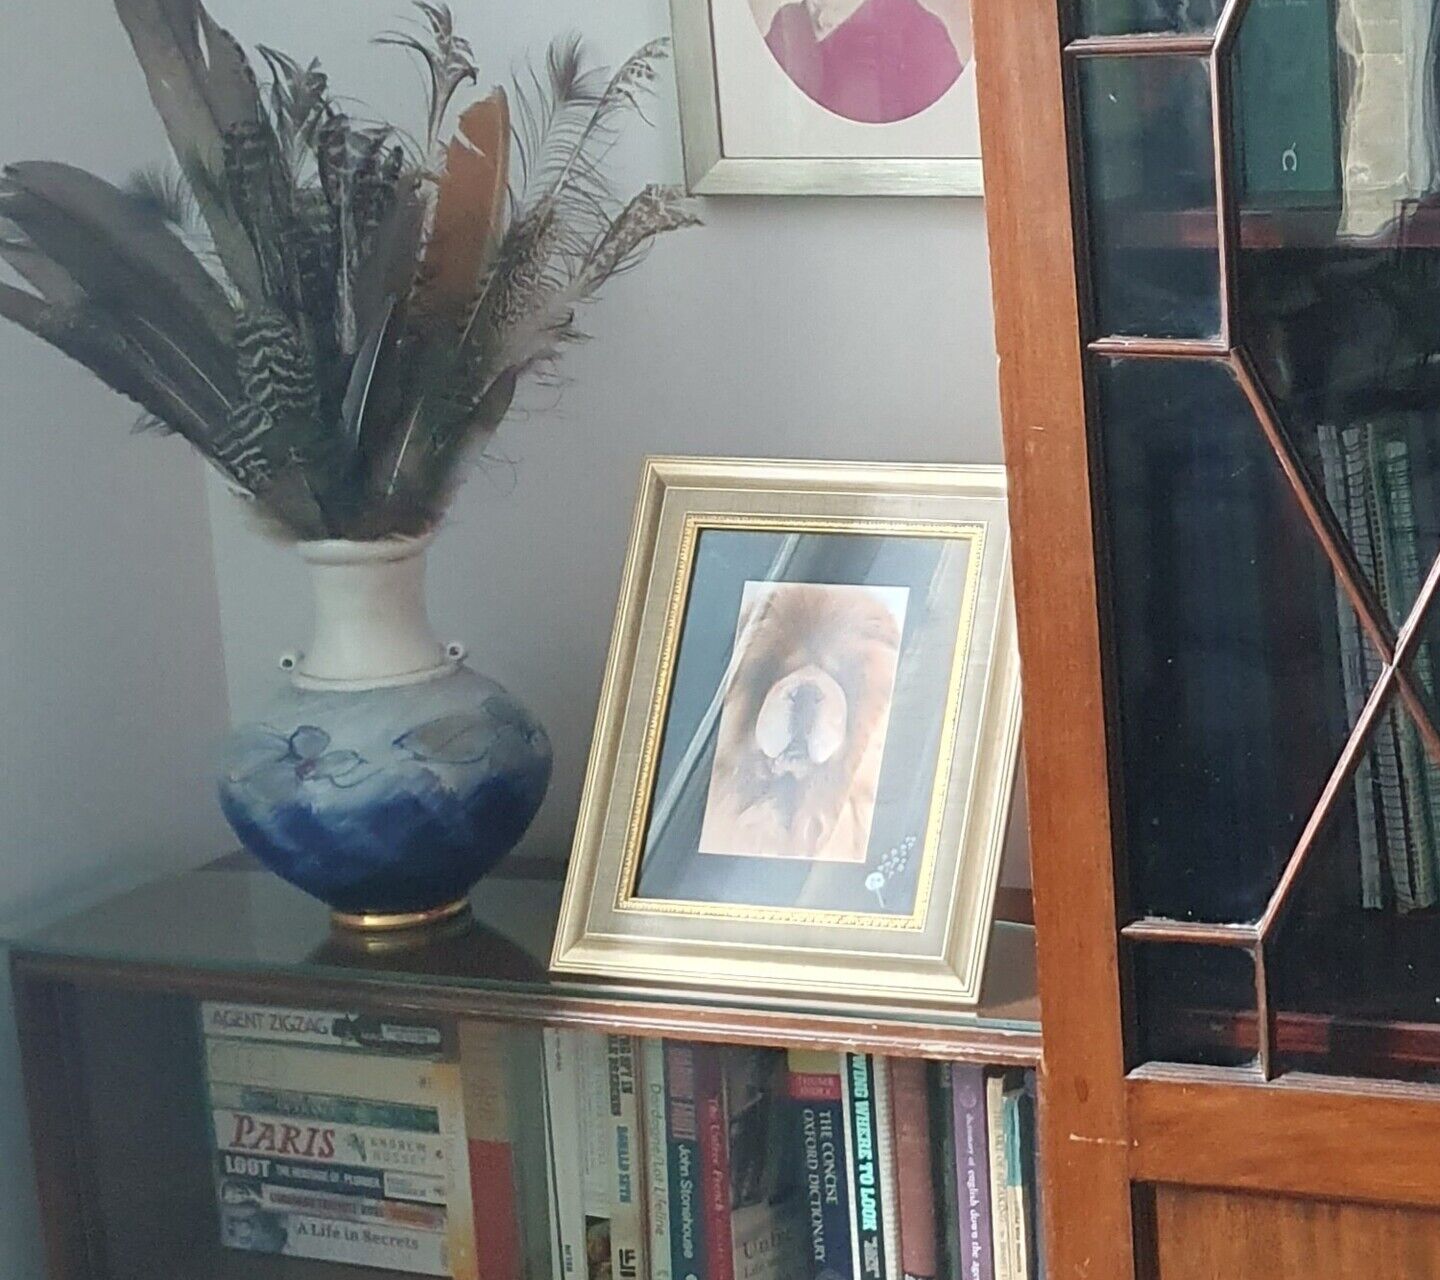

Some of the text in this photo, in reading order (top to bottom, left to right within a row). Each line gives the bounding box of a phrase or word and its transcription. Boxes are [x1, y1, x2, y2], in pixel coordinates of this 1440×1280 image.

[269, 1013, 328, 1035] ZIGZAG
[225, 1155, 272, 1177] LOOT
[228, 1113, 336, 1159] PARIS
[818, 1109, 839, 1206] THE CONCISE
[855, 1101, 877, 1231] WHERE TO LOOK
[677, 1143, 695, 1259] John Stonehouse
[803, 1108, 827, 1263] OXFORD DICTIONARY
[297, 1223, 420, 1251] A Life in Secrets
